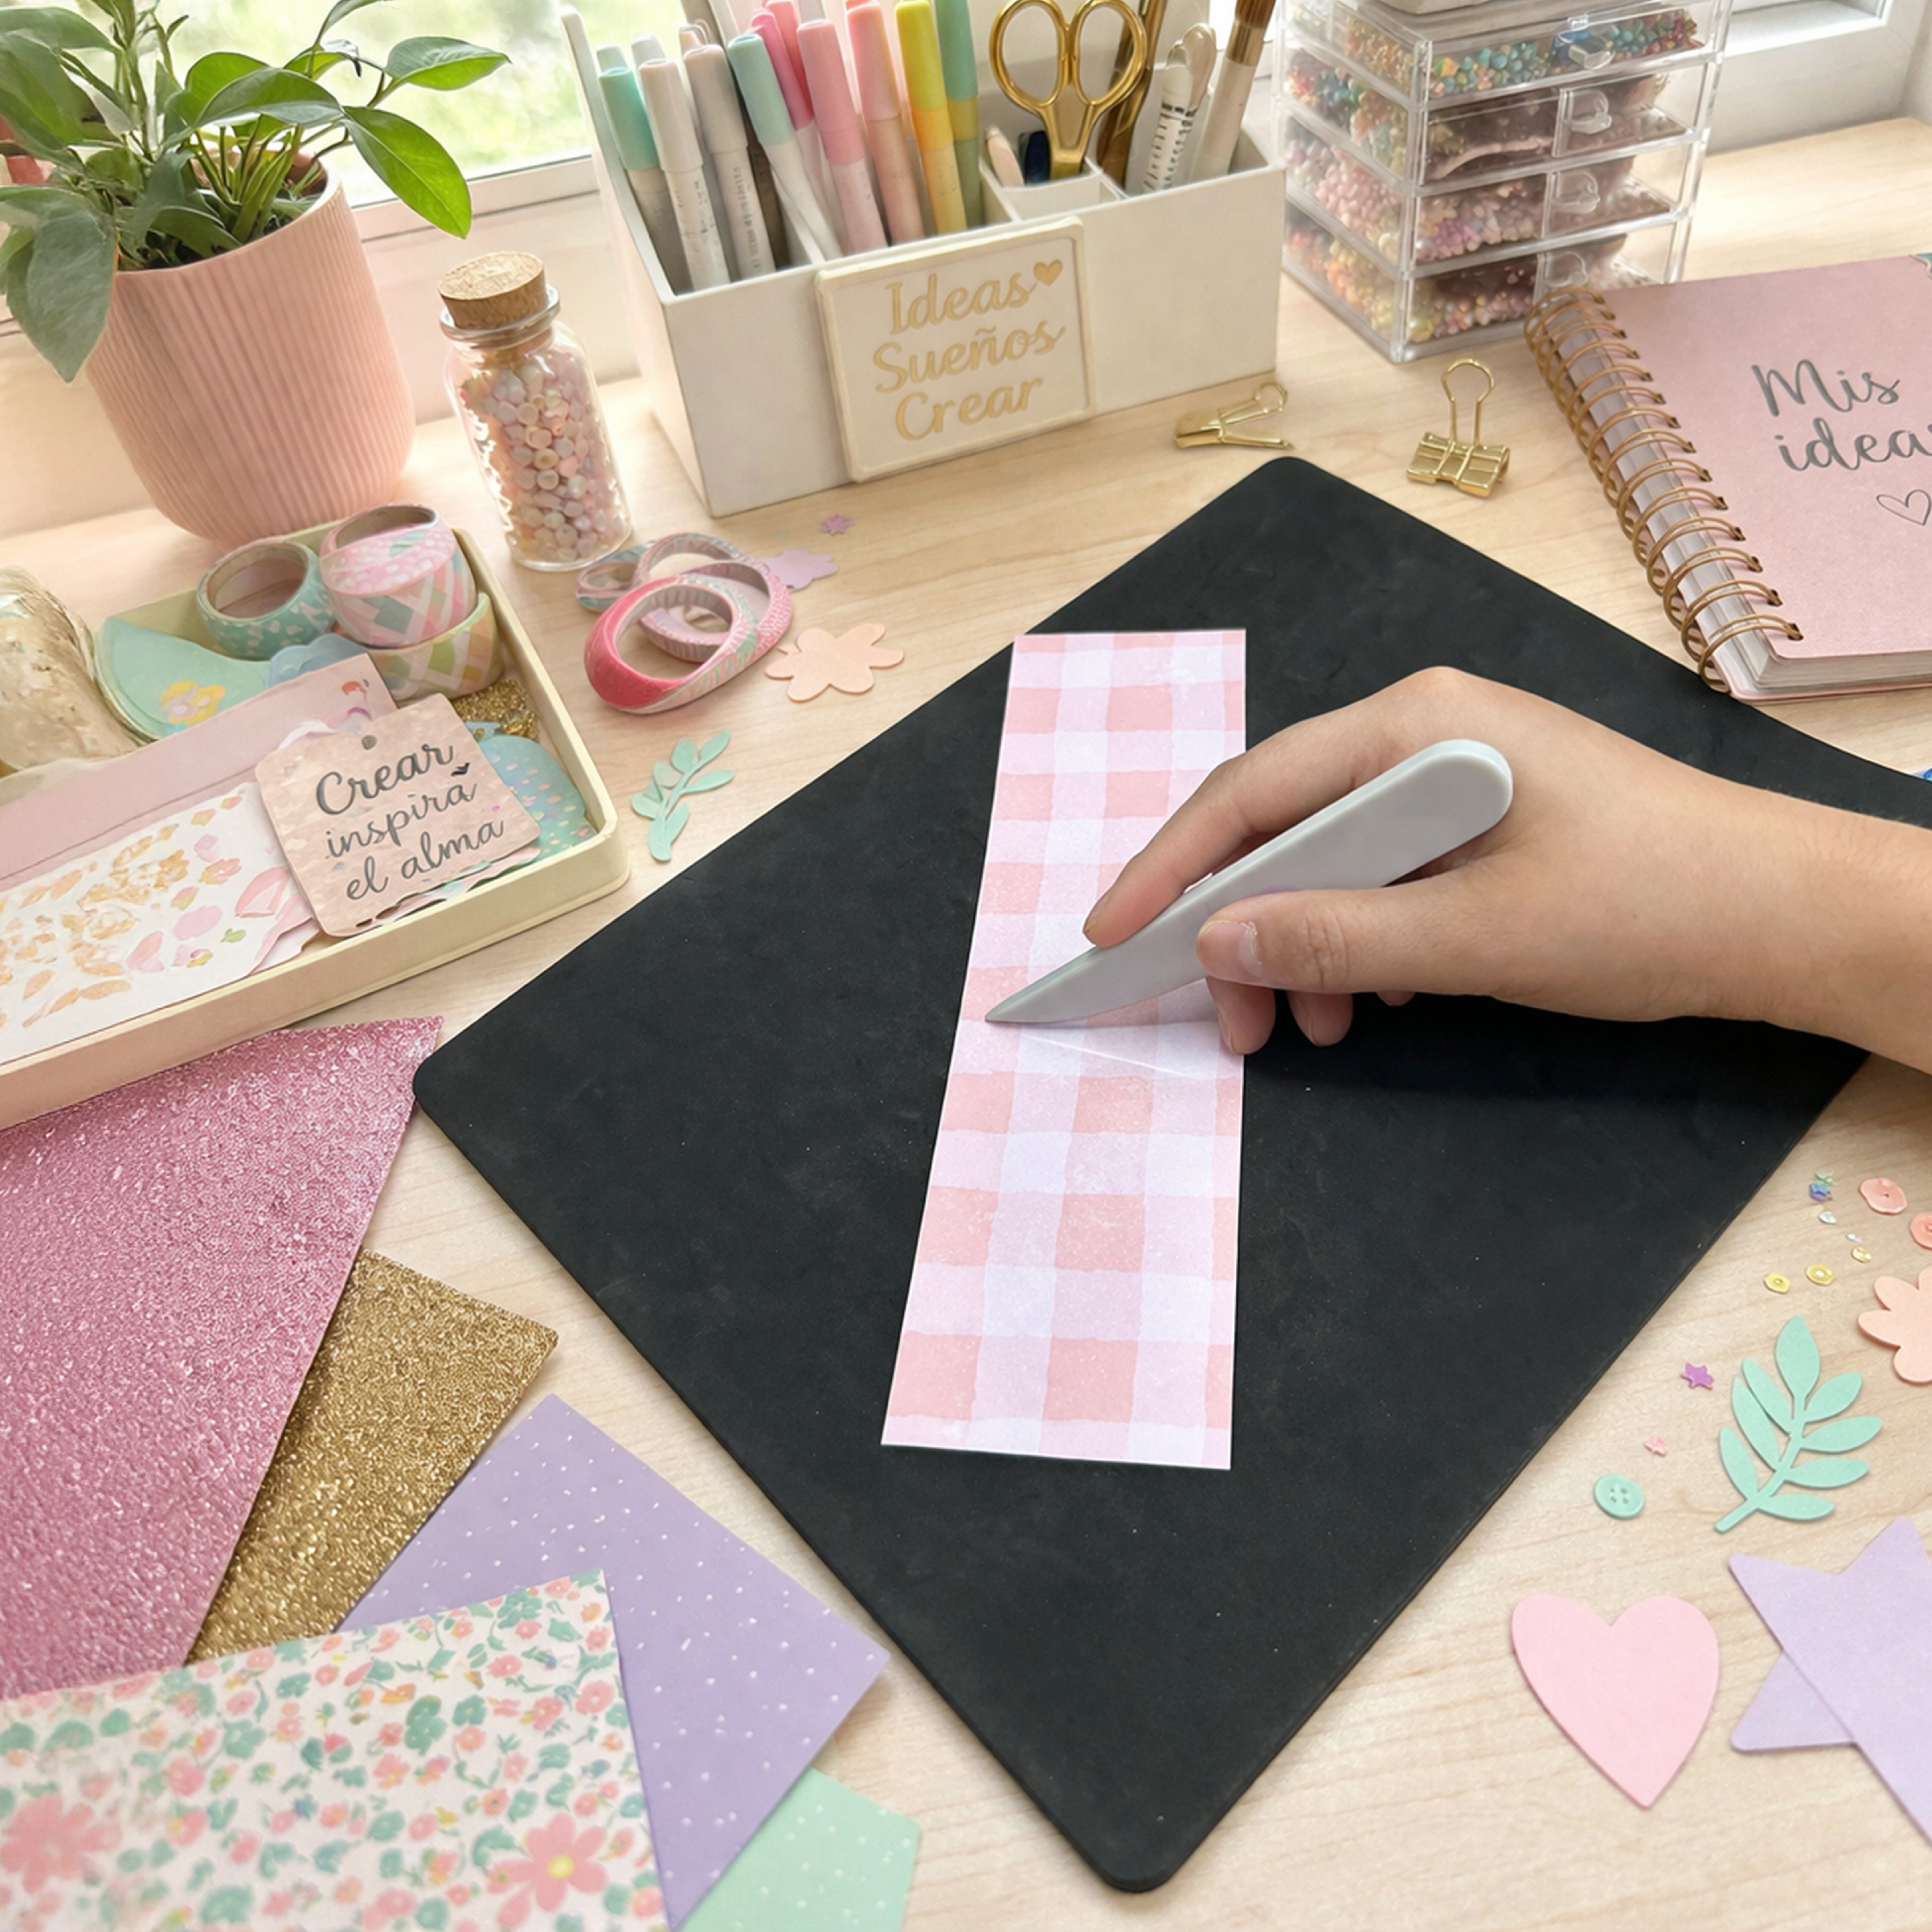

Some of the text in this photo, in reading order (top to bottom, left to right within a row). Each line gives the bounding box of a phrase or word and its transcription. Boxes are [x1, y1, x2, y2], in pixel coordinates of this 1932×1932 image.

[884, 273, 1037, 335] Ideas
[873, 320, 1067, 393] Sueños
[1751, 359, 1900, 417] Mis
[896, 377, 1043, 441] Crear
[1775, 418, 1932, 471] idea
[316, 744, 453, 815] Crear
[325, 782, 477, 858] inspira
[347, 820, 504, 901] el alma
